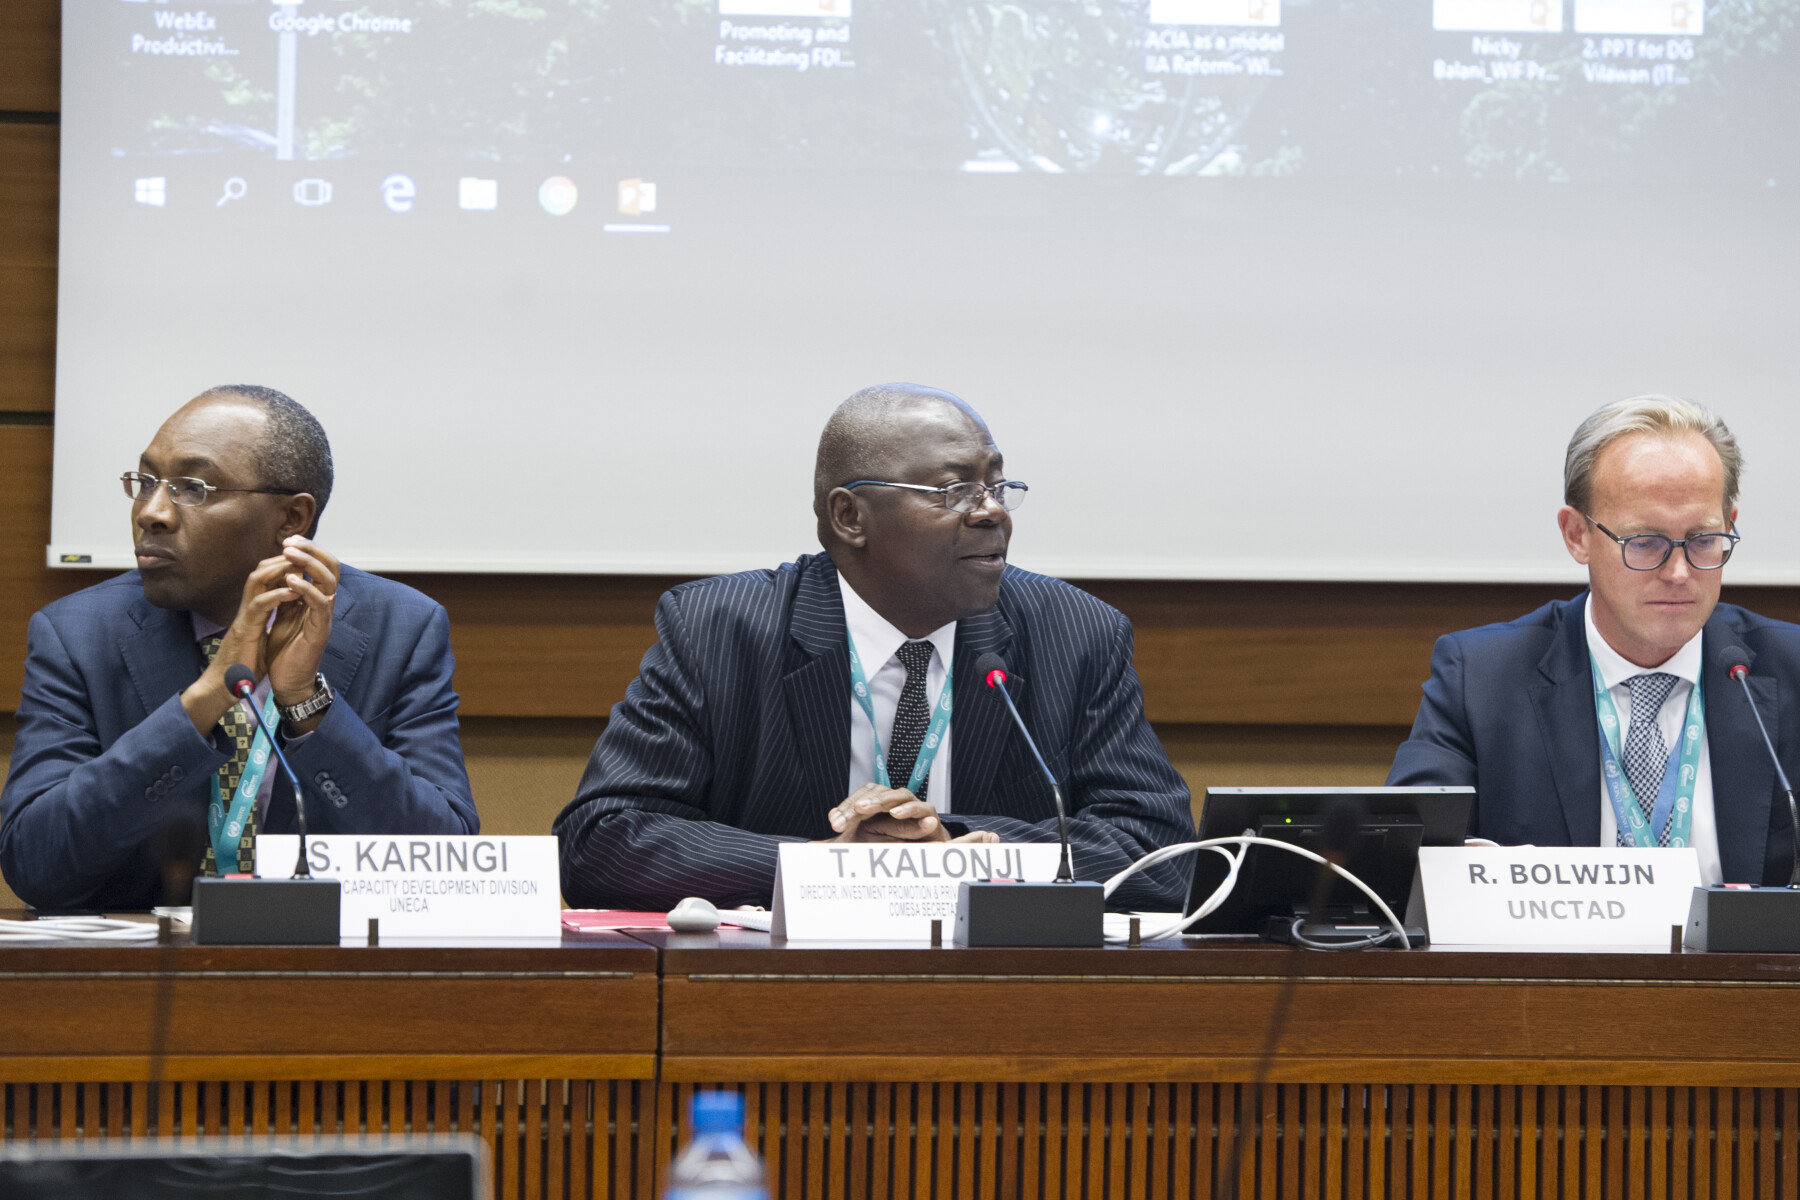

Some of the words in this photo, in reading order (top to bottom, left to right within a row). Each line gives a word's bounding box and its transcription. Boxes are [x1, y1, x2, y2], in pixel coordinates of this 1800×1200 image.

[154, 11, 216, 31] WebEx
[268, 13, 335, 36] Google
[338, 13, 412, 33] Chrome
[719, 20, 813, 47] Promoting
[815, 23, 850, 42] and
[1214, 35, 1226, 50] a
[1229, 32, 1285, 51] model
[714, 45, 809, 72] Facilitating
[1472, 36, 1522, 60] Nicky
[1601, 38, 1635, 58] PPT
[1637, 38, 1664, 59] for
[1666, 39, 1694, 60] DG
[308, 841, 341, 872] S.
[356, 841, 508, 872] KARINGI
[829, 848, 856, 878] T.
[869, 848, 1023, 879] KALONJI
[1468, 864, 1498, 884] R.
[1510, 864, 1655, 885] BOLWIJN
[343, 880, 398, 895] CAPACITY
[402, 880, 486, 895] DEVELOPMENT
[490, 880, 538, 895] DIVISION
[841, 885, 886, 900] INVESTMENT
[888, 885, 932, 900] PROMOTION
[389, 897, 429, 913] UNECA
[889, 902, 920, 917] COMESA
[1508, 900, 1626, 920] UNCTAD
